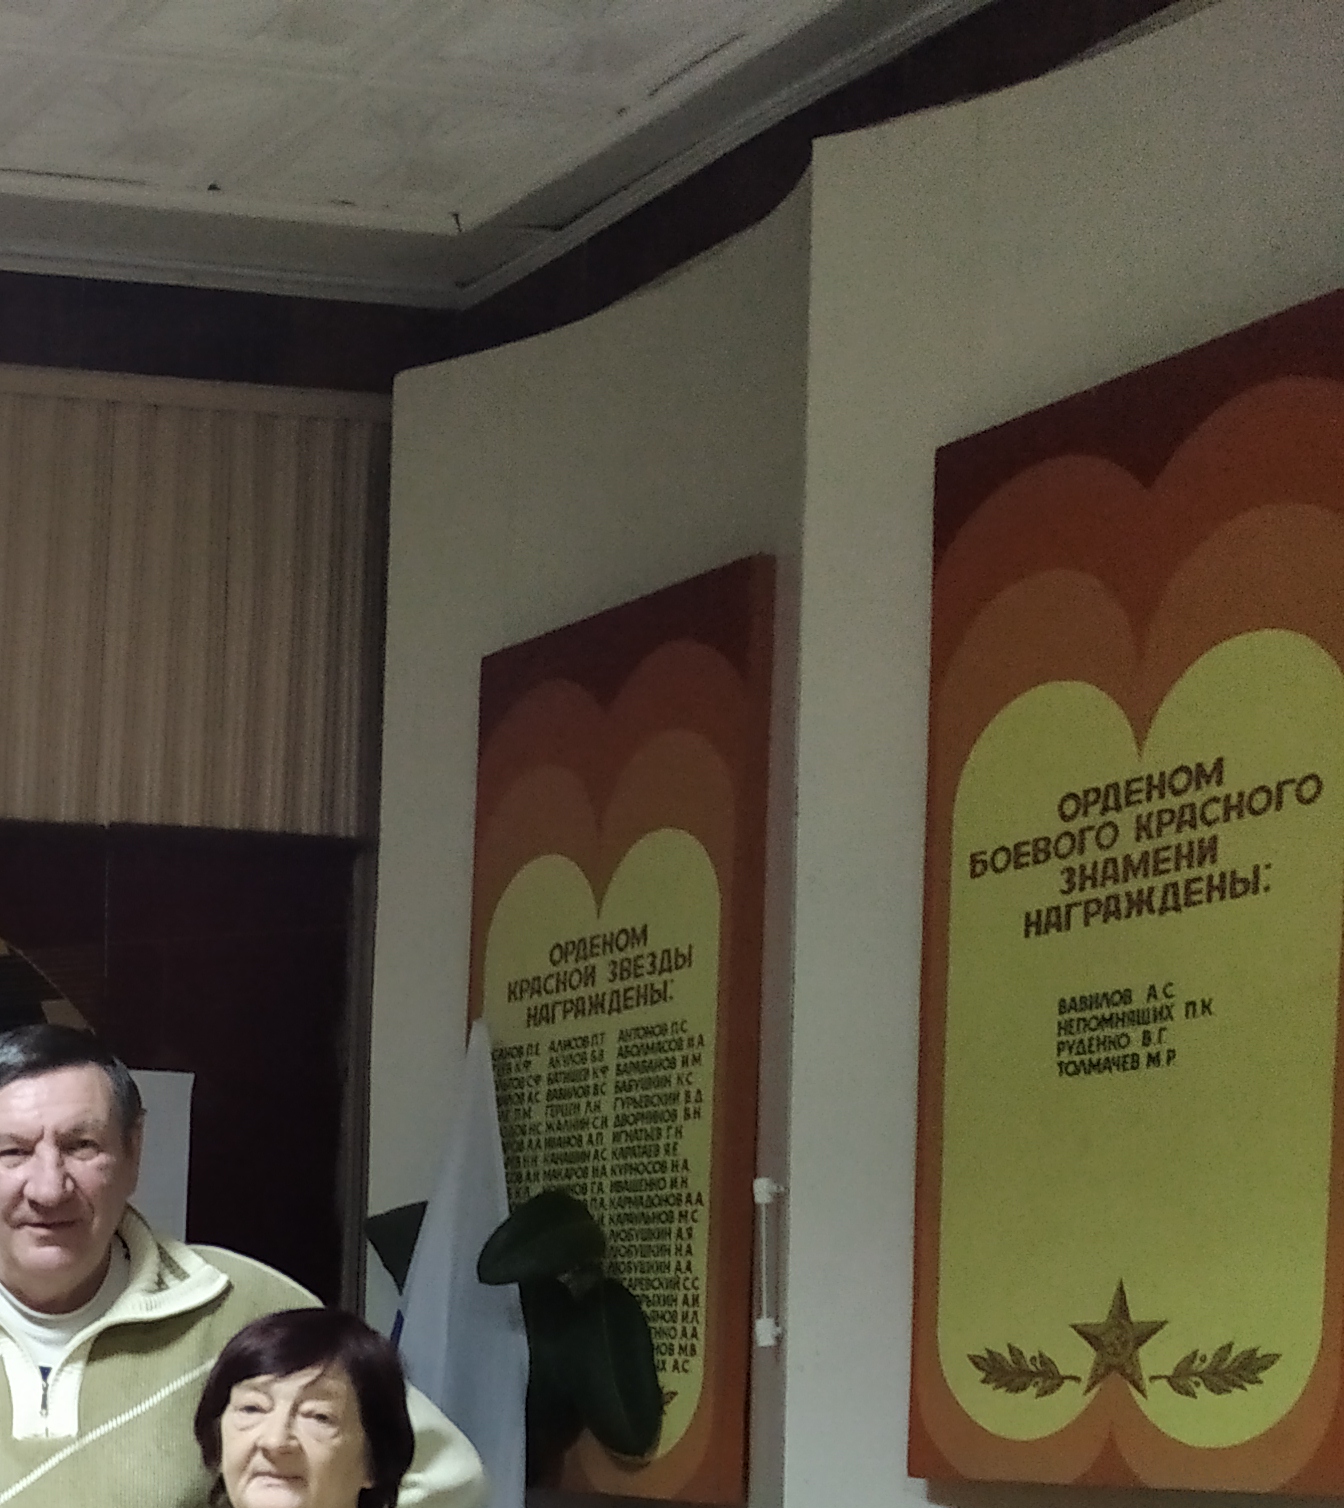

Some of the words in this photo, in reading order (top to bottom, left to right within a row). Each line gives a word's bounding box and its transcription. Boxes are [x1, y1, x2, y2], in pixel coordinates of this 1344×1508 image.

[1057, 756, 1225, 823] ОРДЕНОМ
[969, 821, 1120, 880] БОЕВОГО
[1135, 773, 1324, 842] КРАСНОГО
[1060, 835, 1219, 896] ЗНАМЕНИ
[1024, 863, 1272, 939] НАГРАЖДЕНЫ:
[507, 964, 596, 1003] КРАСНОЙ
[608, 943, 693, 983] ЗВЕЗДЫ
[549, 923, 648, 967] ОРДЕНОМ
[526, 979, 674, 1028] НАГРАЖДЕНЫ:
[1056, 1052, 1140, 1077] ТОЛМАЧЕВ
